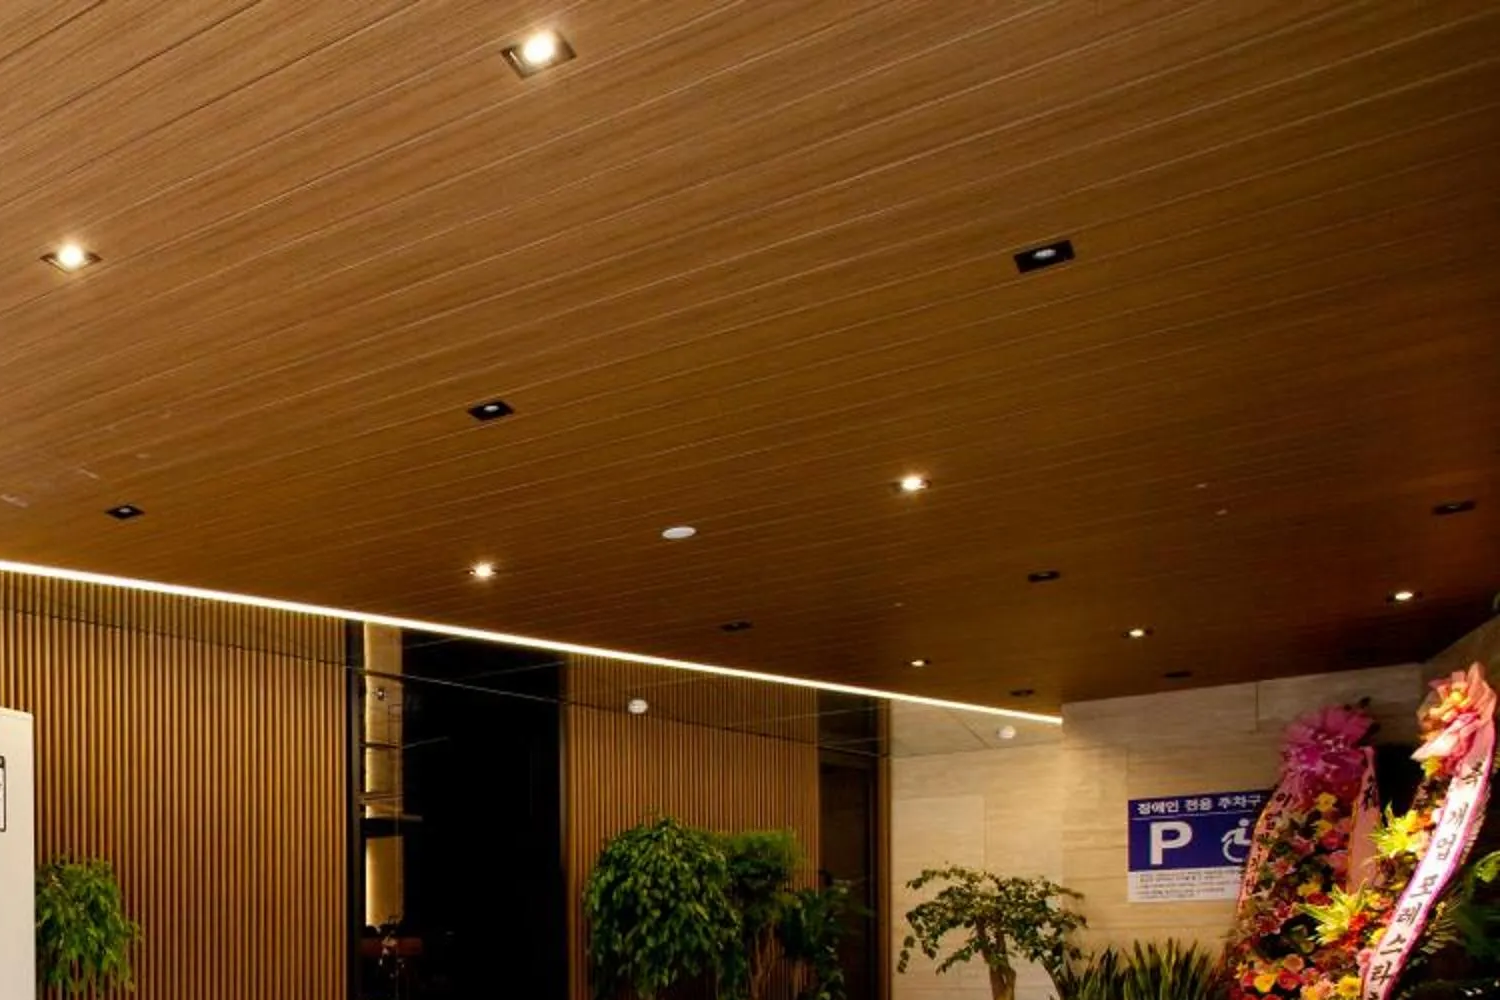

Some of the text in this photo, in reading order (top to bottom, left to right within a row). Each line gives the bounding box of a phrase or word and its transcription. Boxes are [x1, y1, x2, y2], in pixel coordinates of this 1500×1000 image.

[1137, 794, 1266, 815] 장애인 전용 주차구
[1150, 820, 1193, 866] P
